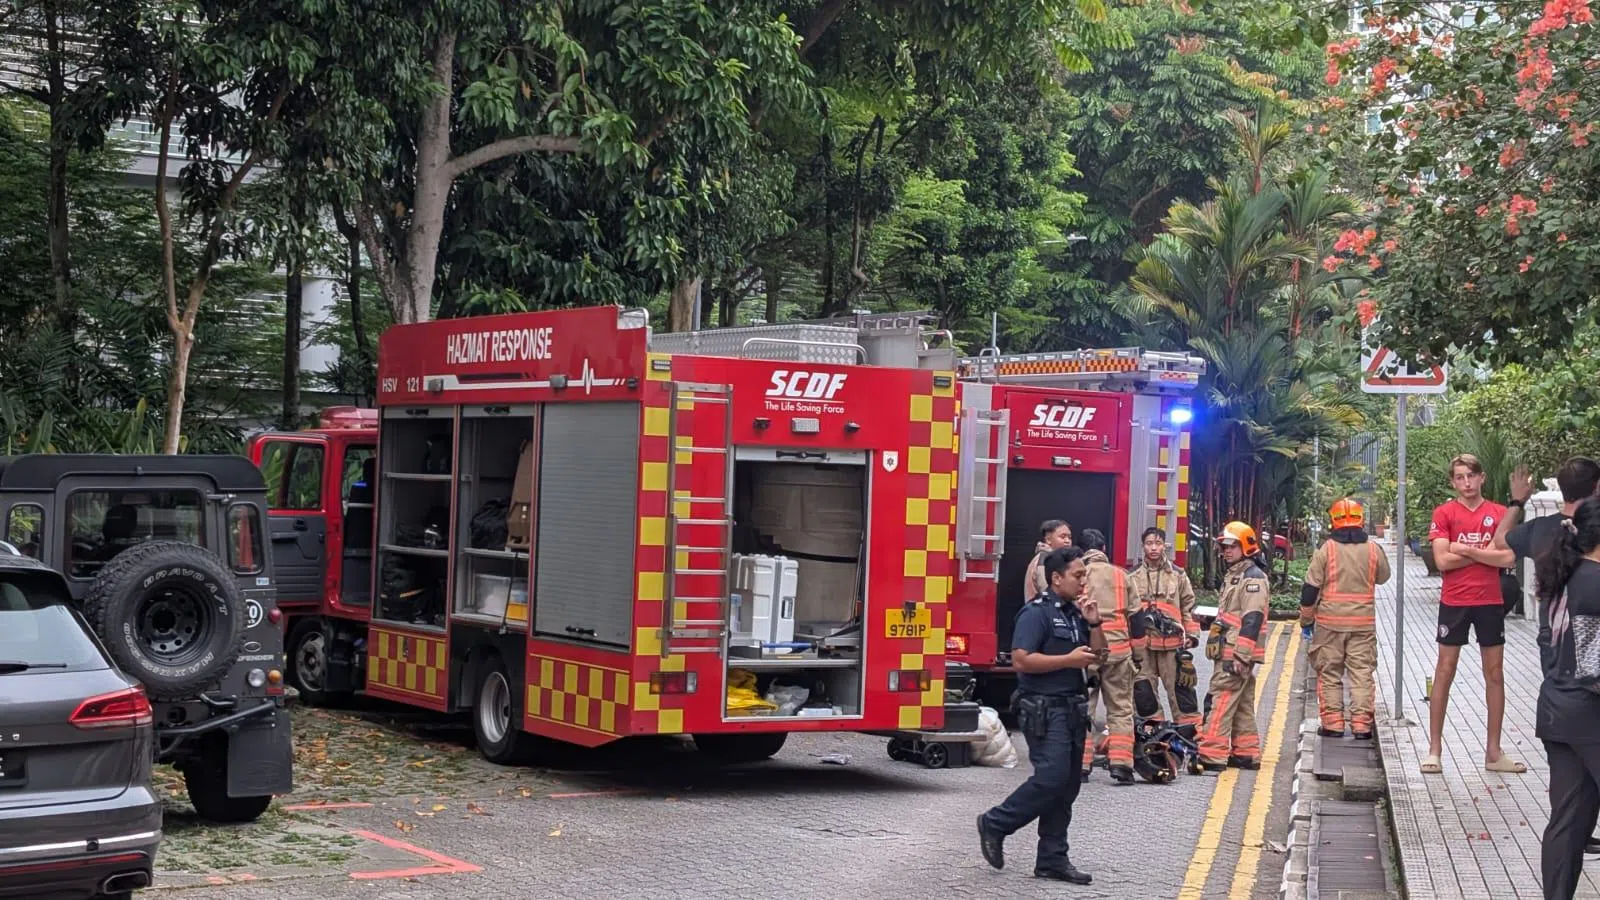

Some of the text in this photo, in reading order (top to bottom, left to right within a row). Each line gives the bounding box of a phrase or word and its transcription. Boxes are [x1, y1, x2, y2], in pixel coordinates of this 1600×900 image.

[447, 327, 553, 364] HAZMAT RESPONSE
[382, 377, 419, 393] HSV 121
[765, 370, 848, 399] SCDF
[765, 400, 845, 415] The Life Saving Force
[1029, 404, 1097, 429] SCDF
[1027, 428, 1098, 442] The Life Saving Force
[1456, 532, 1492, 544] ASIA
[901, 611, 916, 623] YP
[890, 624, 926, 637] 9781P
